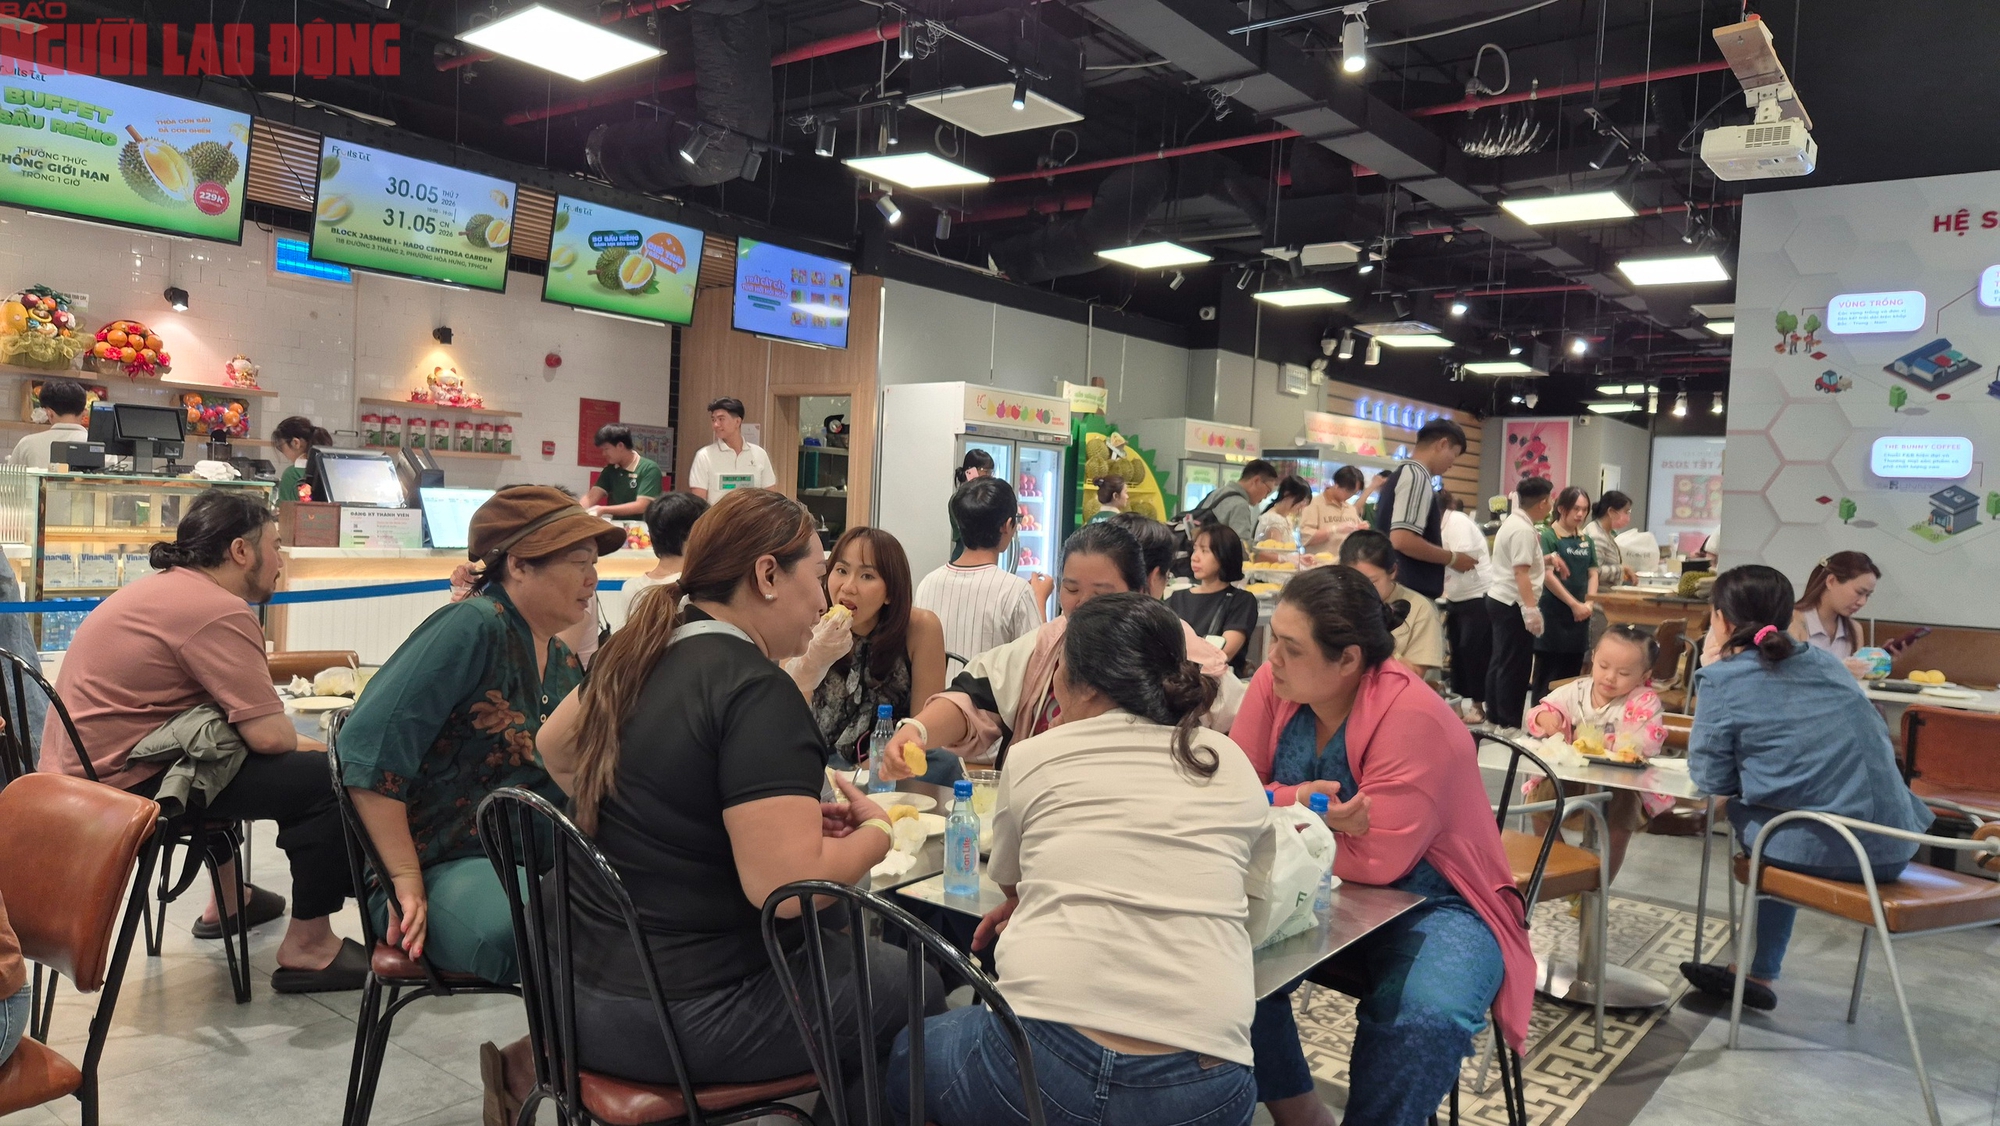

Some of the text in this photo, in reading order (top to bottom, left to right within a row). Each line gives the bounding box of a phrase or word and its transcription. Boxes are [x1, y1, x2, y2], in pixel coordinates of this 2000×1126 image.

[4, 86, 114, 124] BUFFET
[50, 118, 118, 147] RIÊNG
[0, 153, 110, 183] HÔNG GIỚI HẠN
[62, 154, 88, 167] THỨC
[21, 170, 55, 182] TRONG
[63, 177, 81, 187] GIỜ
[199, 191, 225, 204] 229K
[385, 176, 438, 204] 30.05
[442, 190, 454, 199] THỨ
[441, 199, 456, 208] 2026
[383, 208, 436, 234] 31.05
[1933, 208, 1971, 236] HỆ
[438, 229, 453, 237] 2026
[331, 227, 357, 238] BLOCK
[359, 233, 392, 245] JASMINE
[403, 241, 424, 250] HADO
[426, 244, 463, 258] CENTROSA
[465, 253, 493, 263] GARDEN
[377, 244, 399, 254] THÁNG
[406, 250, 433, 261] PHƯỜNG
[1838, 297, 1904, 308] VÙNG TRỒNG
[44, 553, 72, 561] inamilk
[81, 553, 114, 561] Vinamilk
